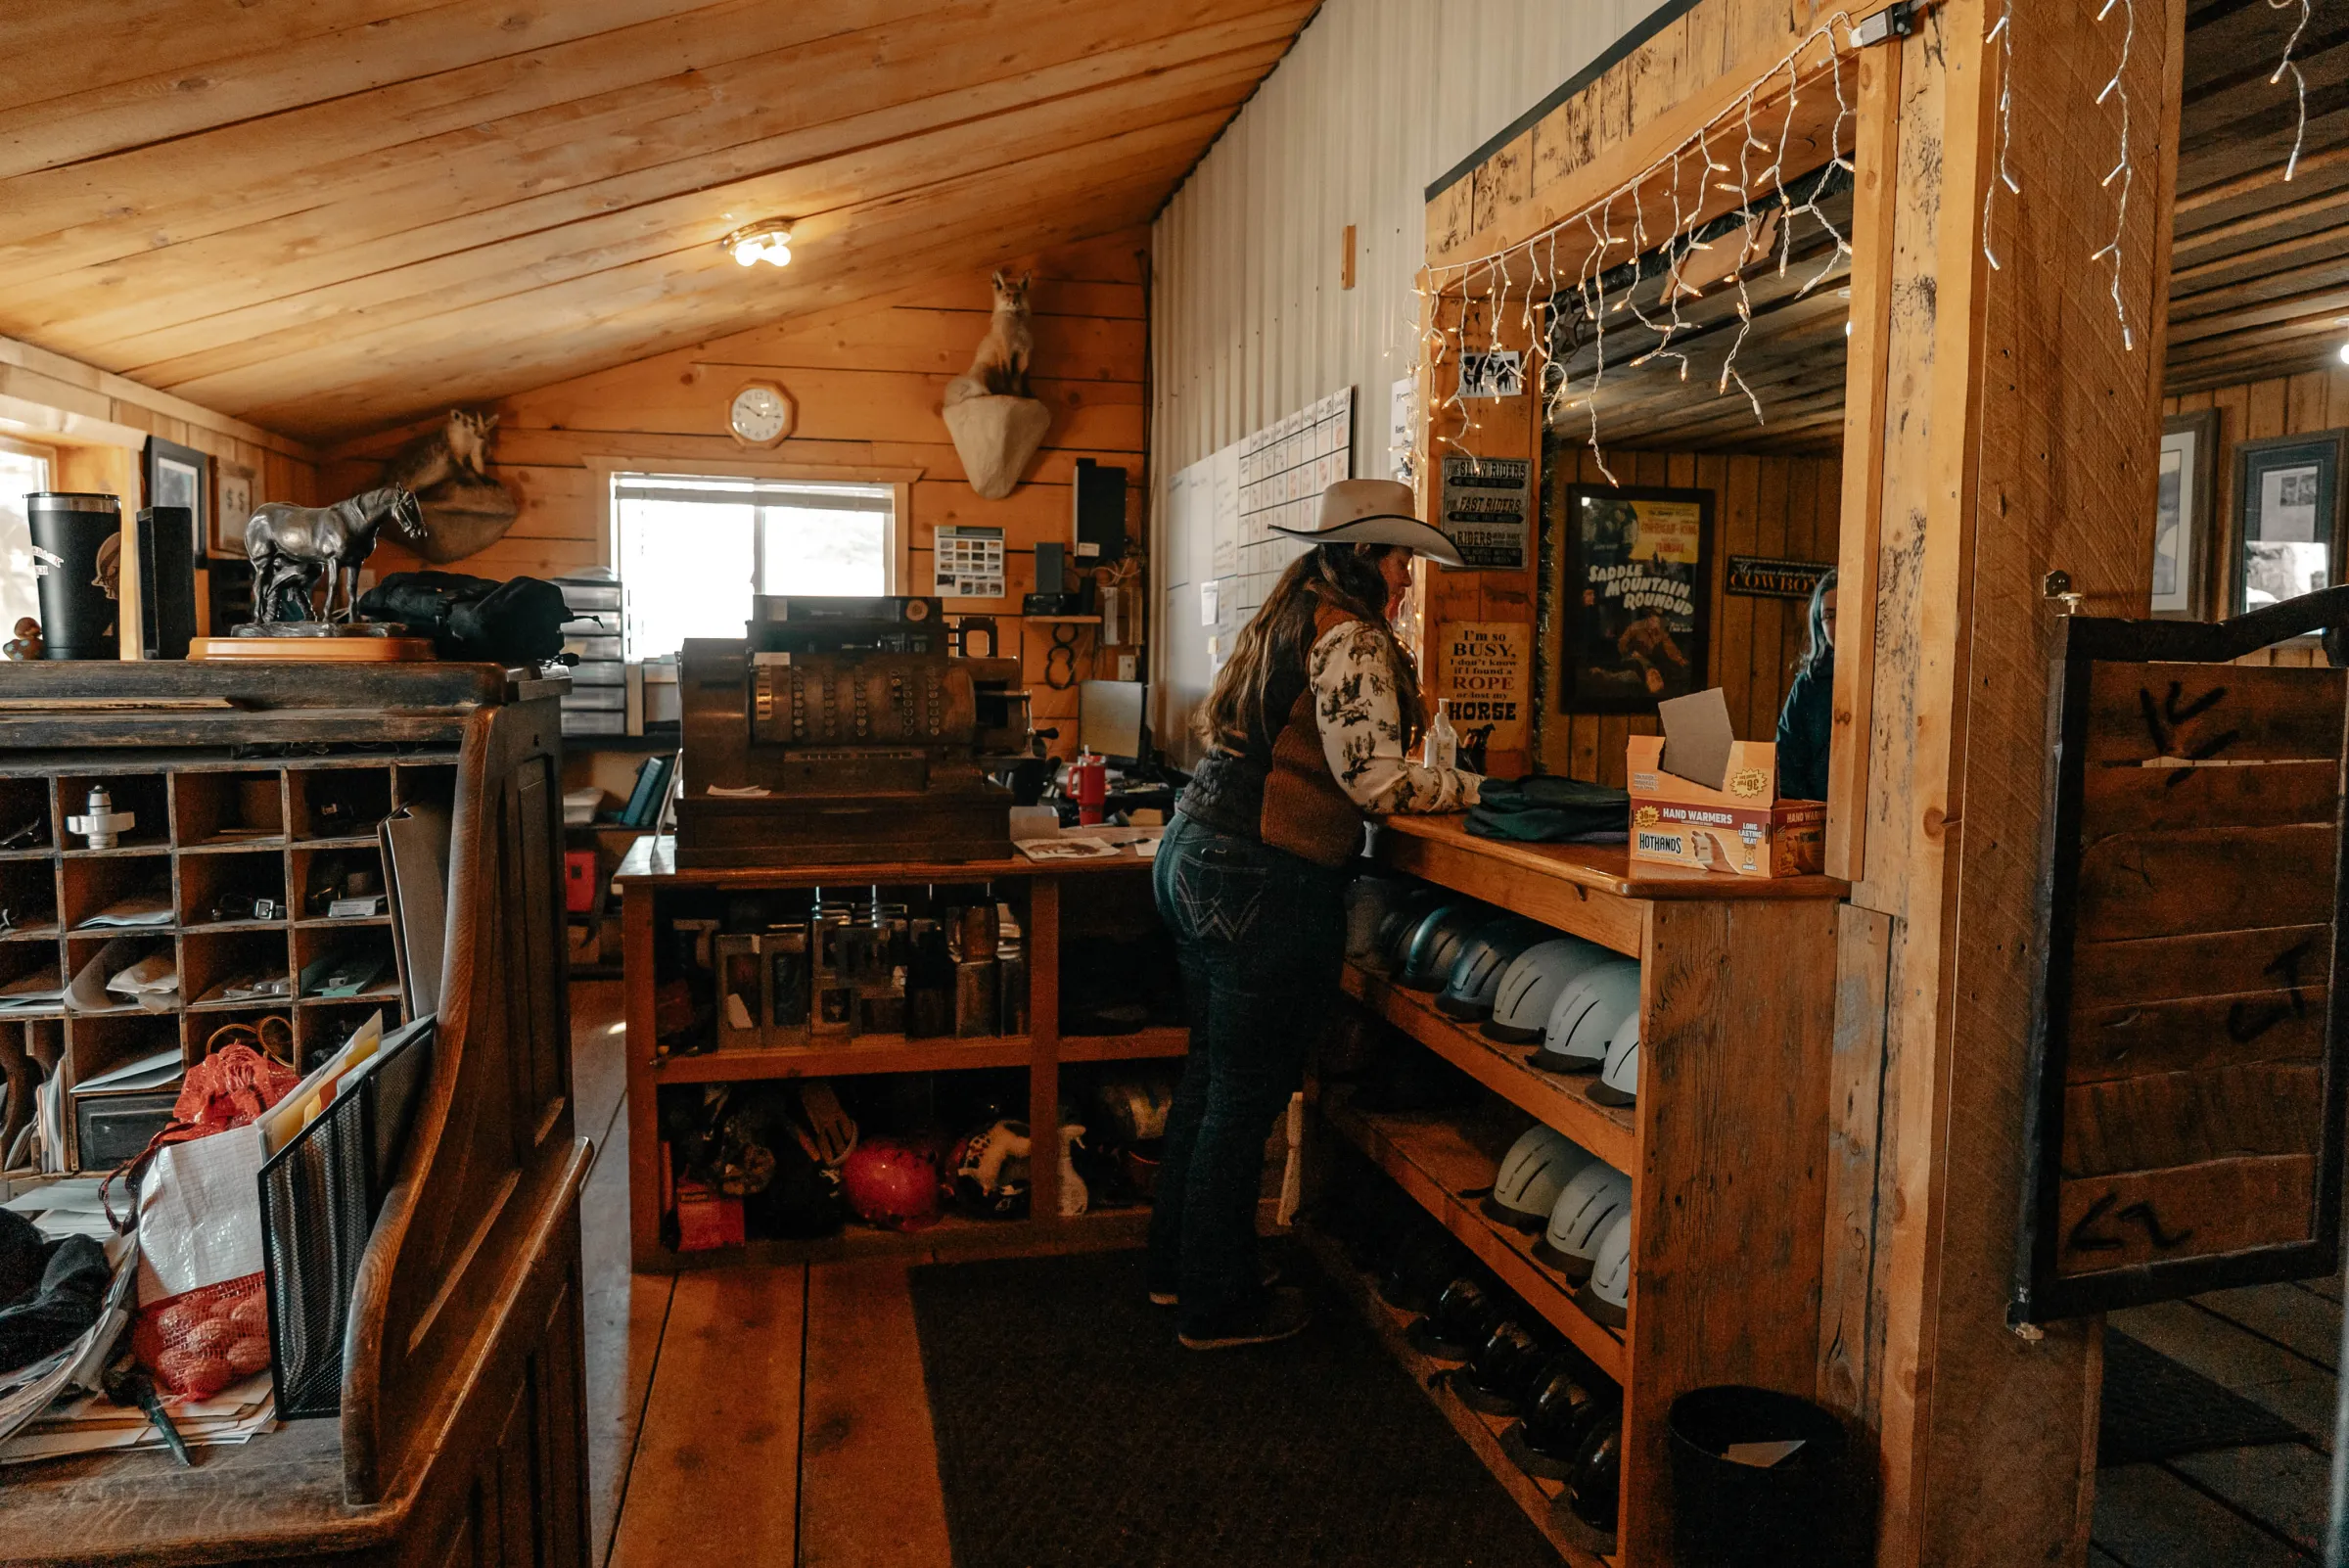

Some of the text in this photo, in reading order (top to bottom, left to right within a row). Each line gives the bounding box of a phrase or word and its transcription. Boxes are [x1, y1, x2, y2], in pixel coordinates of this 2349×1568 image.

[1491, 463, 1526, 479] RIDERS
[1458, 496, 1484, 512] FAST
[1485, 497, 1522, 513] RIDERS
[1456, 530, 1493, 546] RIDERS
[1589, 564, 1643, 582] SADDLE
[1605, 576, 1690, 599] MOUNTAIN
[1624, 592, 1694, 616] ROUNDUP
[1464, 630, 1506, 642] I'm so
[1453, 643, 1516, 658] BUSY,
[1452, 676, 1515, 690] ROPE
[1449, 702, 1516, 720] HORSE
[1747, 779, 1760, 791] 36
[1639, 810, 1649, 820] 36
[1663, 807, 1686, 820] HAND
[1687, 810, 1732, 825] WARMERS
[1786, 812, 1804, 823] HAND
[1738, 829, 1763, 838] LASTING
[1742, 822, 1758, 831] LONG
[1639, 833, 1681, 854] HOTHANDS
[1745, 848, 1755, 864] 8
